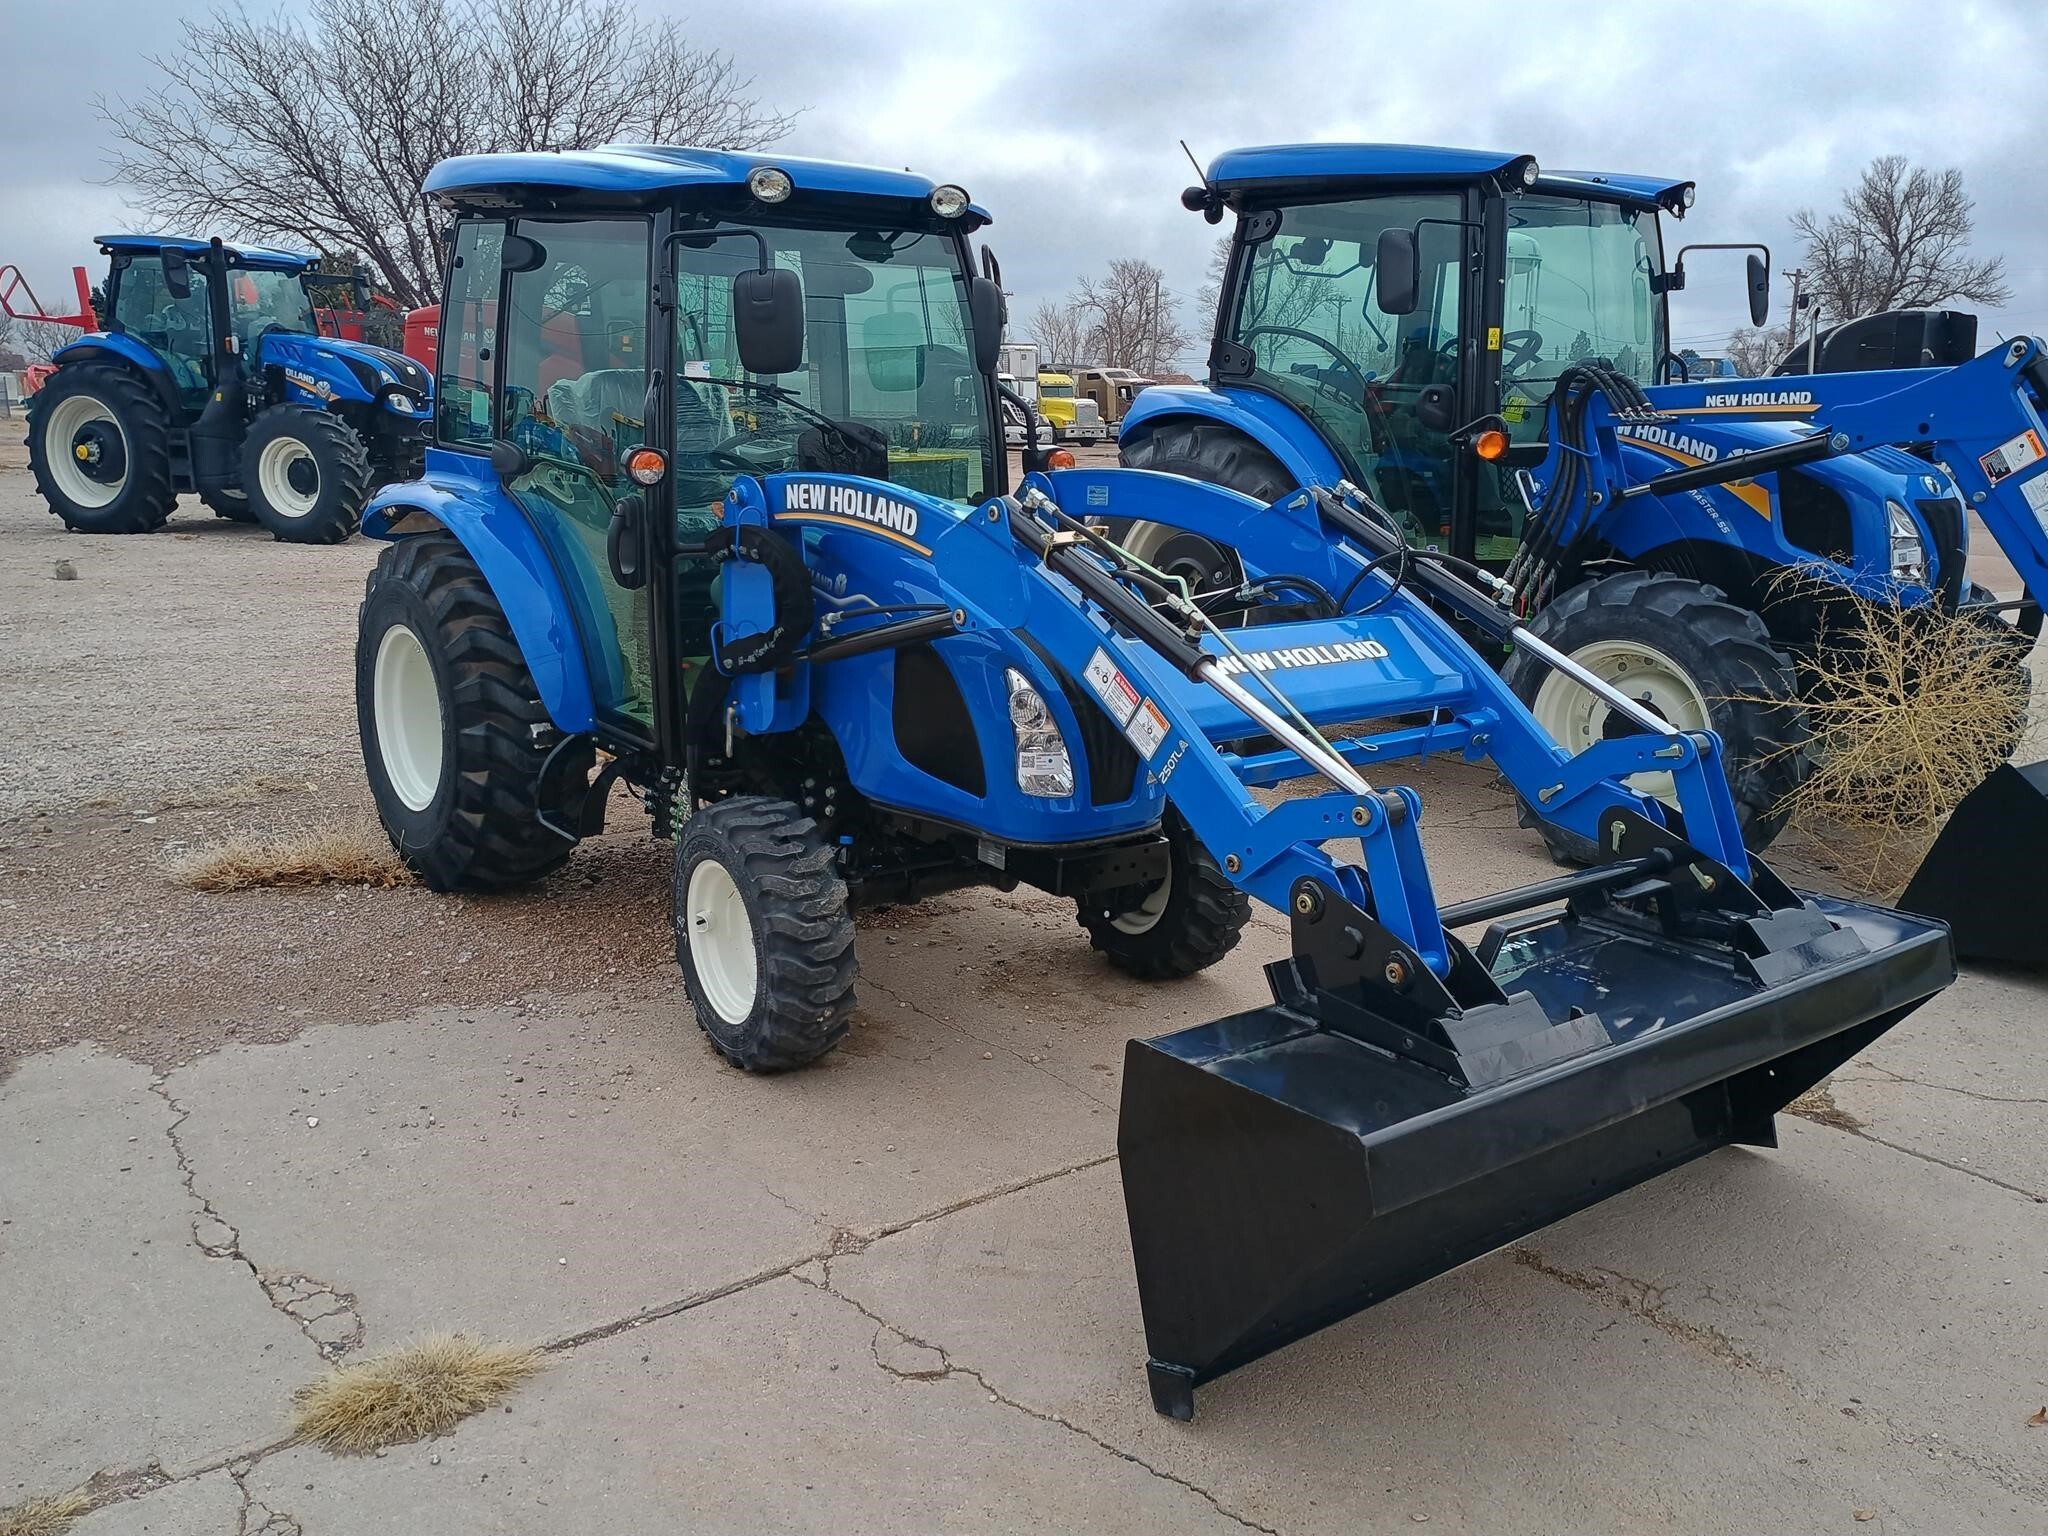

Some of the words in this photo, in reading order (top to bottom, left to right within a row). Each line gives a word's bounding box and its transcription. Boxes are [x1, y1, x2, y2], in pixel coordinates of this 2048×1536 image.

[285, 367, 315, 385] OLLAND
[1705, 393, 1739, 408] NEW
[1741, 391, 1812, 406] HOLLAND
[1635, 425, 1718, 463] HOLLAND
[786, 483, 826, 511] NEW
[829, 486, 919, 537] HOLLAND
[1215, 651, 1278, 677] NEW
[1272, 639, 1390, 668] HOLLAND
[1158, 740, 1189, 784] 250TLA
